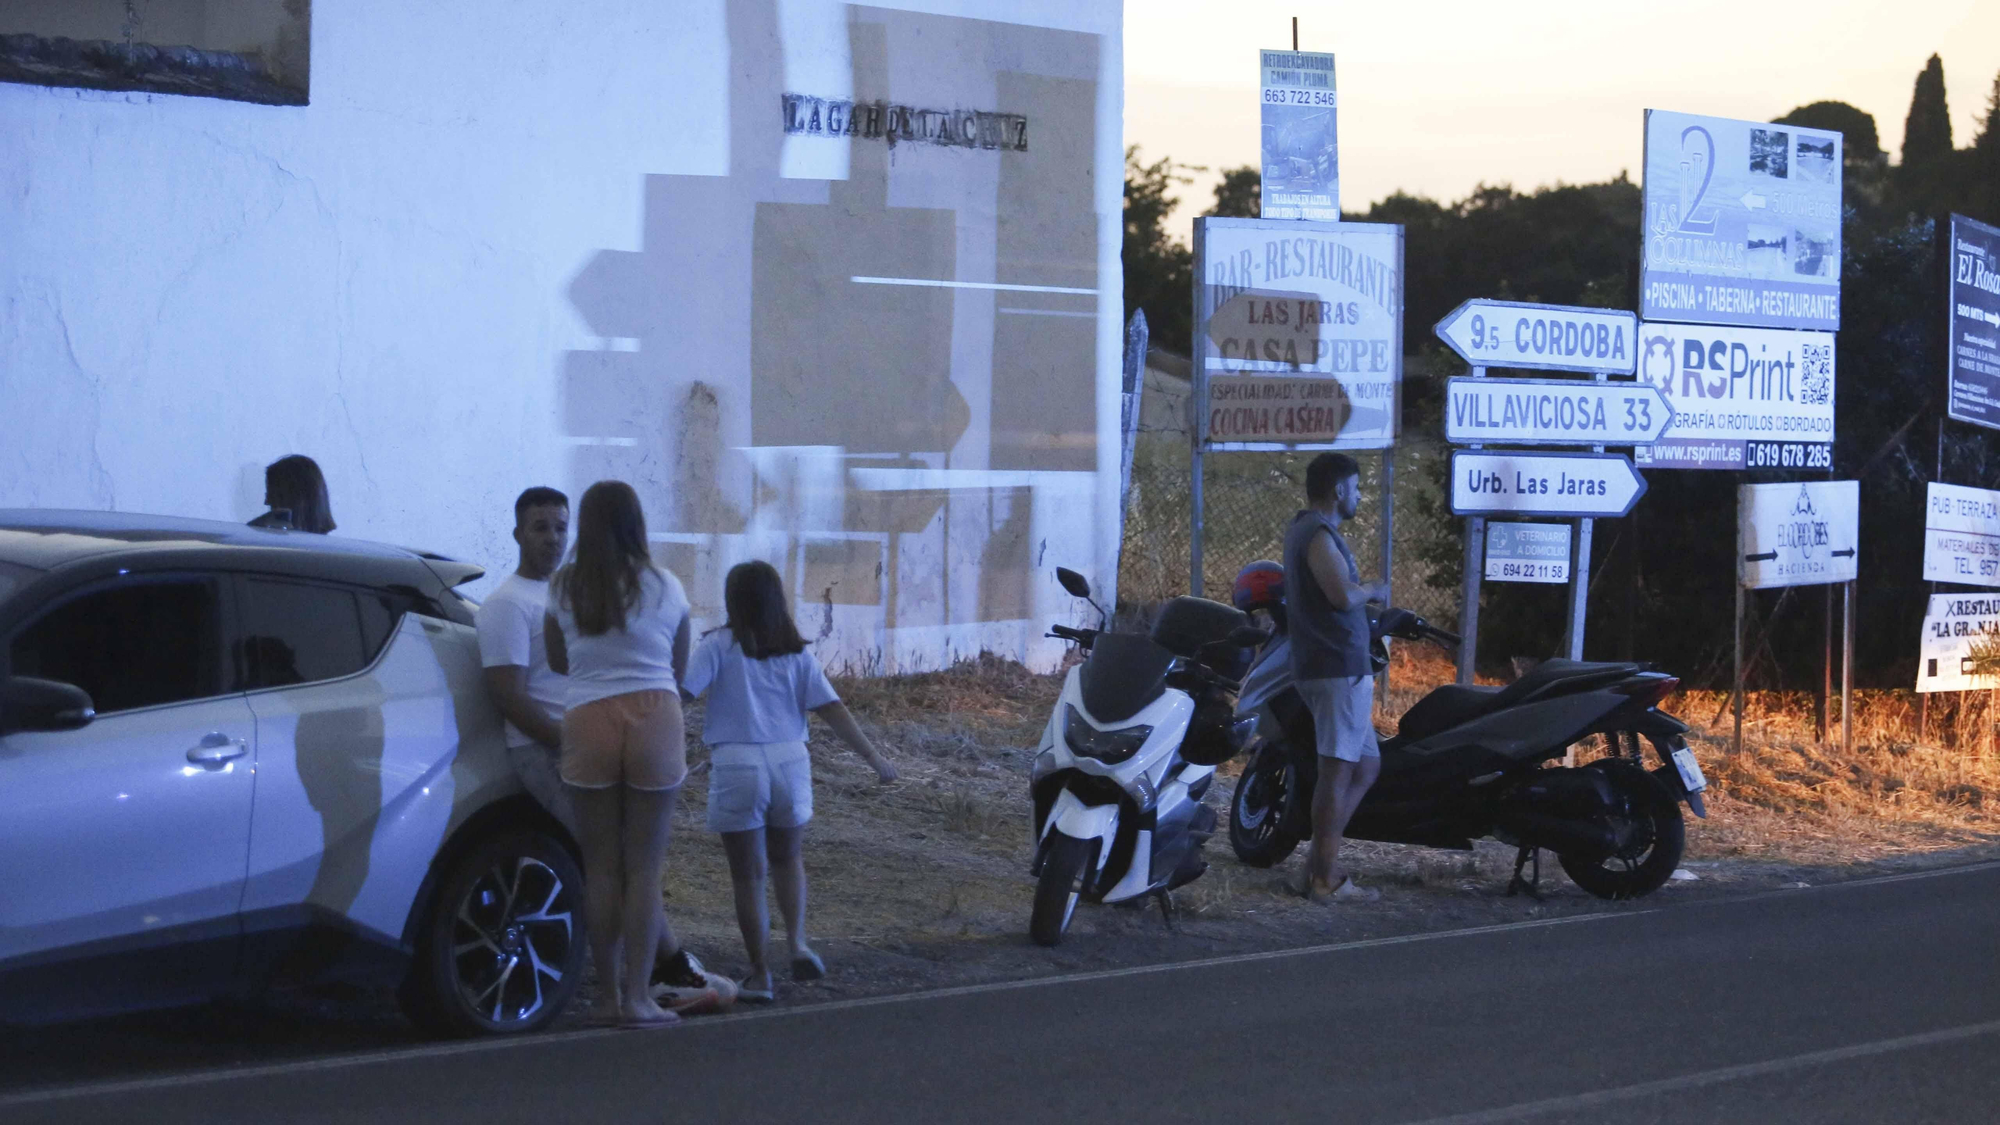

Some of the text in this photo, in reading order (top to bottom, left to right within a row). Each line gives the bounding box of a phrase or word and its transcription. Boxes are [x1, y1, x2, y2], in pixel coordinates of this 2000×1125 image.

[1263, 53, 1334, 71] RETROEXCAVADORA
[1303, 72, 1329, 87] PLUMA
[1265, 89, 1335, 106] 663 722 546
[1650, 202, 1677, 236] LAS
[1772, 192, 1838, 220] 500 Metros
[1650, 236, 1744, 271] COLUMNAS
[1956, 253, 1973, 285] El
[1651, 282, 1837, 320] PISCINA TABERNA RESTAURANTE
[1957, 303, 1984, 322] 500 MTS
[1249, 301, 1360, 333] LAS JARAS
[1515, 317, 1626, 361] CORDOBA
[1221, 338, 1389, 374] CASA PEPE
[1682, 338, 1795, 402] RSPrint
[1356, 382, 1392, 400] MONTE
[1211, 406, 1335, 436] COCINA CASERA
[1454, 393, 1651, 432] VILLAVICIOSA 33
[1673, 409, 1832, 433] GRAFÍA RÓTULOS BORDADO
[1654, 442, 1831, 468] www.rsprint.es 619 678 285
[1468, 469, 1607, 496] Urb. Las Jaras
[1515, 530, 1567, 543] VETERINARIO
[1937, 537, 1985, 555] MATERIALES
[1517, 545, 1523, 555] A
[1525, 545, 1566, 557] DOMICILIO
[1503, 563, 1563, 578] 694 22 11 58
[1778, 562, 1825, 575] HACIENDA
[1980, 559, 1999, 577] 957
